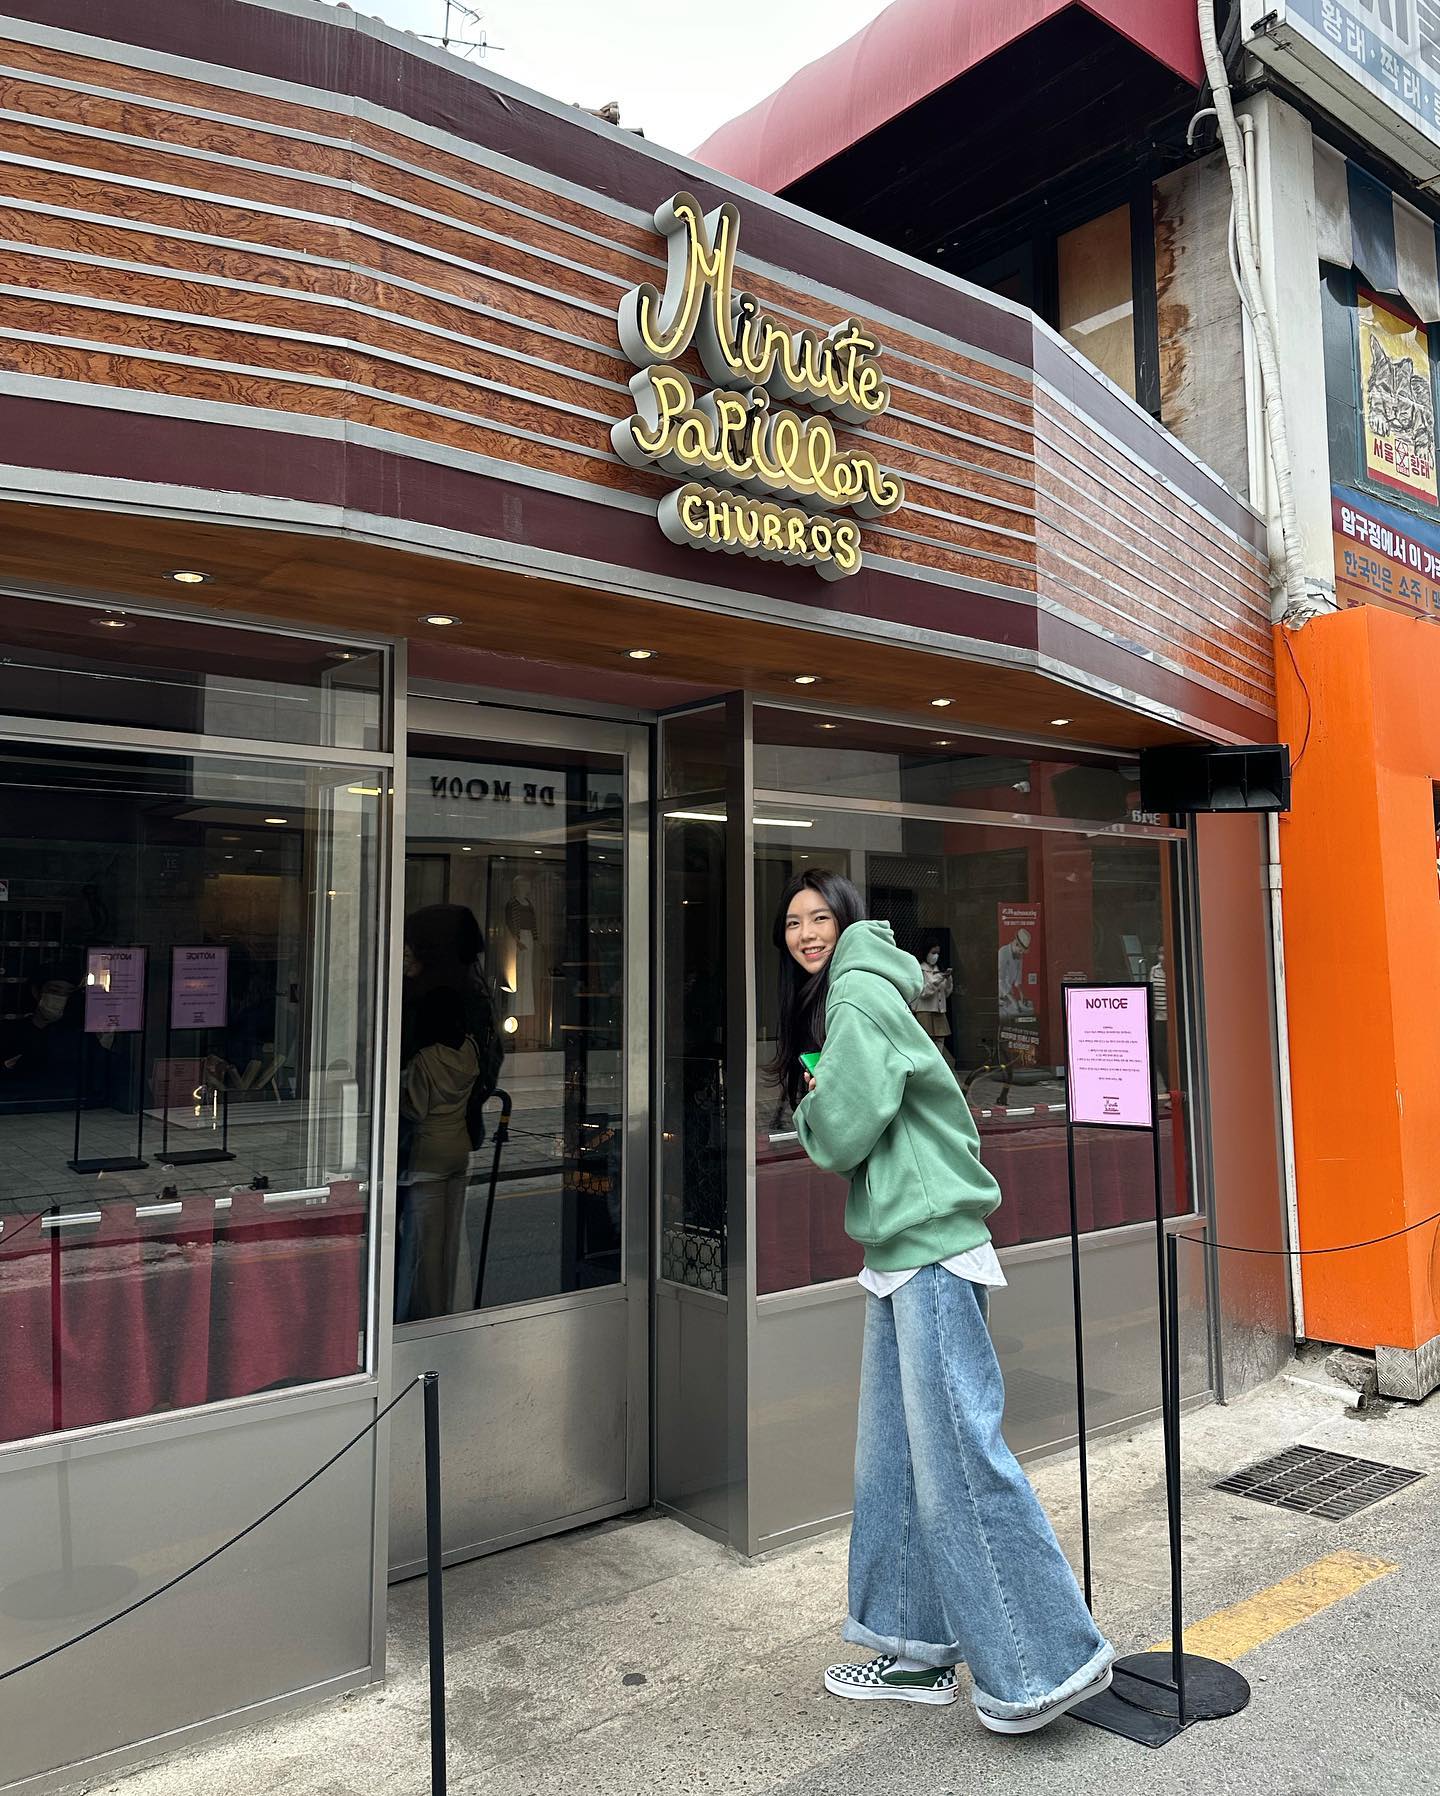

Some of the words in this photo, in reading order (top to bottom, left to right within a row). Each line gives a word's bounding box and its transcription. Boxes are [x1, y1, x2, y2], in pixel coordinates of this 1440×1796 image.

[637, 200, 888, 414] Minute
[1374, 438, 1394, 464] 서울
[1410, 454, 1430, 479] 황태
[680, 493, 856, 569] CHURROS
[1341, 506, 1406, 563] 압구정에서
[1409, 543, 1422, 571] 이
[1343, 550, 1393, 593] 한국인은
[1398, 575, 1422, 604] 소주
[1085, 997, 1128, 1010] NOTICE
